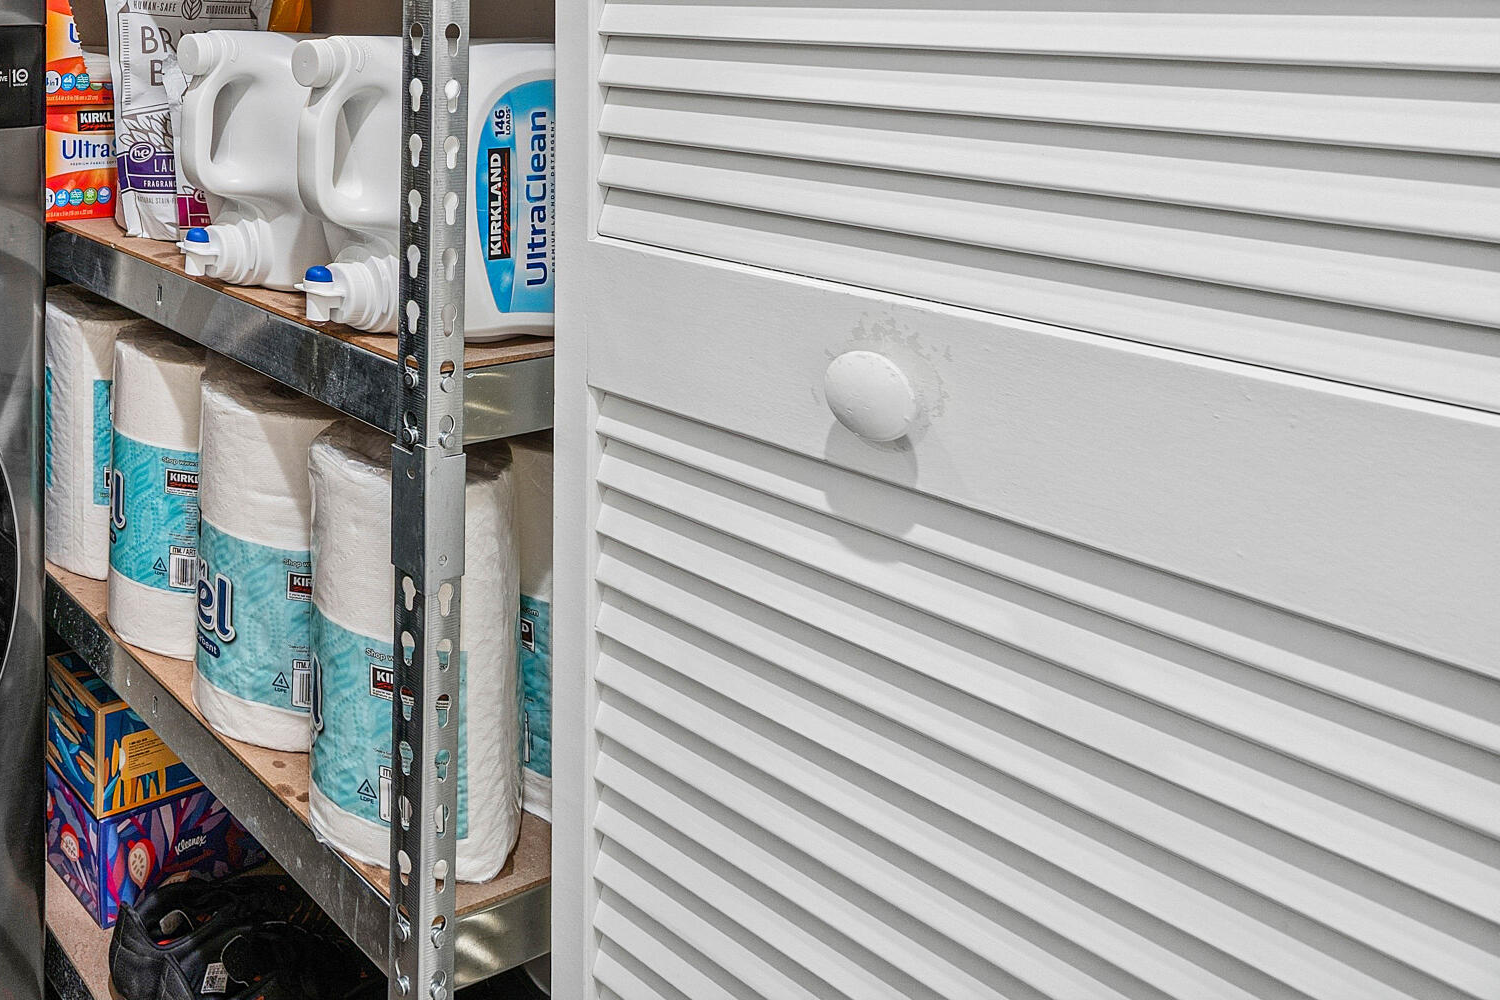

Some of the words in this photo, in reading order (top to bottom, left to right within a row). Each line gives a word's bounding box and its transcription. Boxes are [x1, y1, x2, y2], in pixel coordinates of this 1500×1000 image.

[133, 0, 177, 13] HUMAN-SAFE
[12, 68, 29, 83] 10
[80, 112, 114, 123] KIRKL
[494, 109, 505, 138] 146
[490, 152, 501, 255] KIRKLAND
[500, 151, 511, 255] Signature
[526, 110, 547, 287] UltraClean
[365, 648, 387, 661] Shop
[360, 795, 375, 805] LDPE
[174, 834, 207, 856] Kleenex
